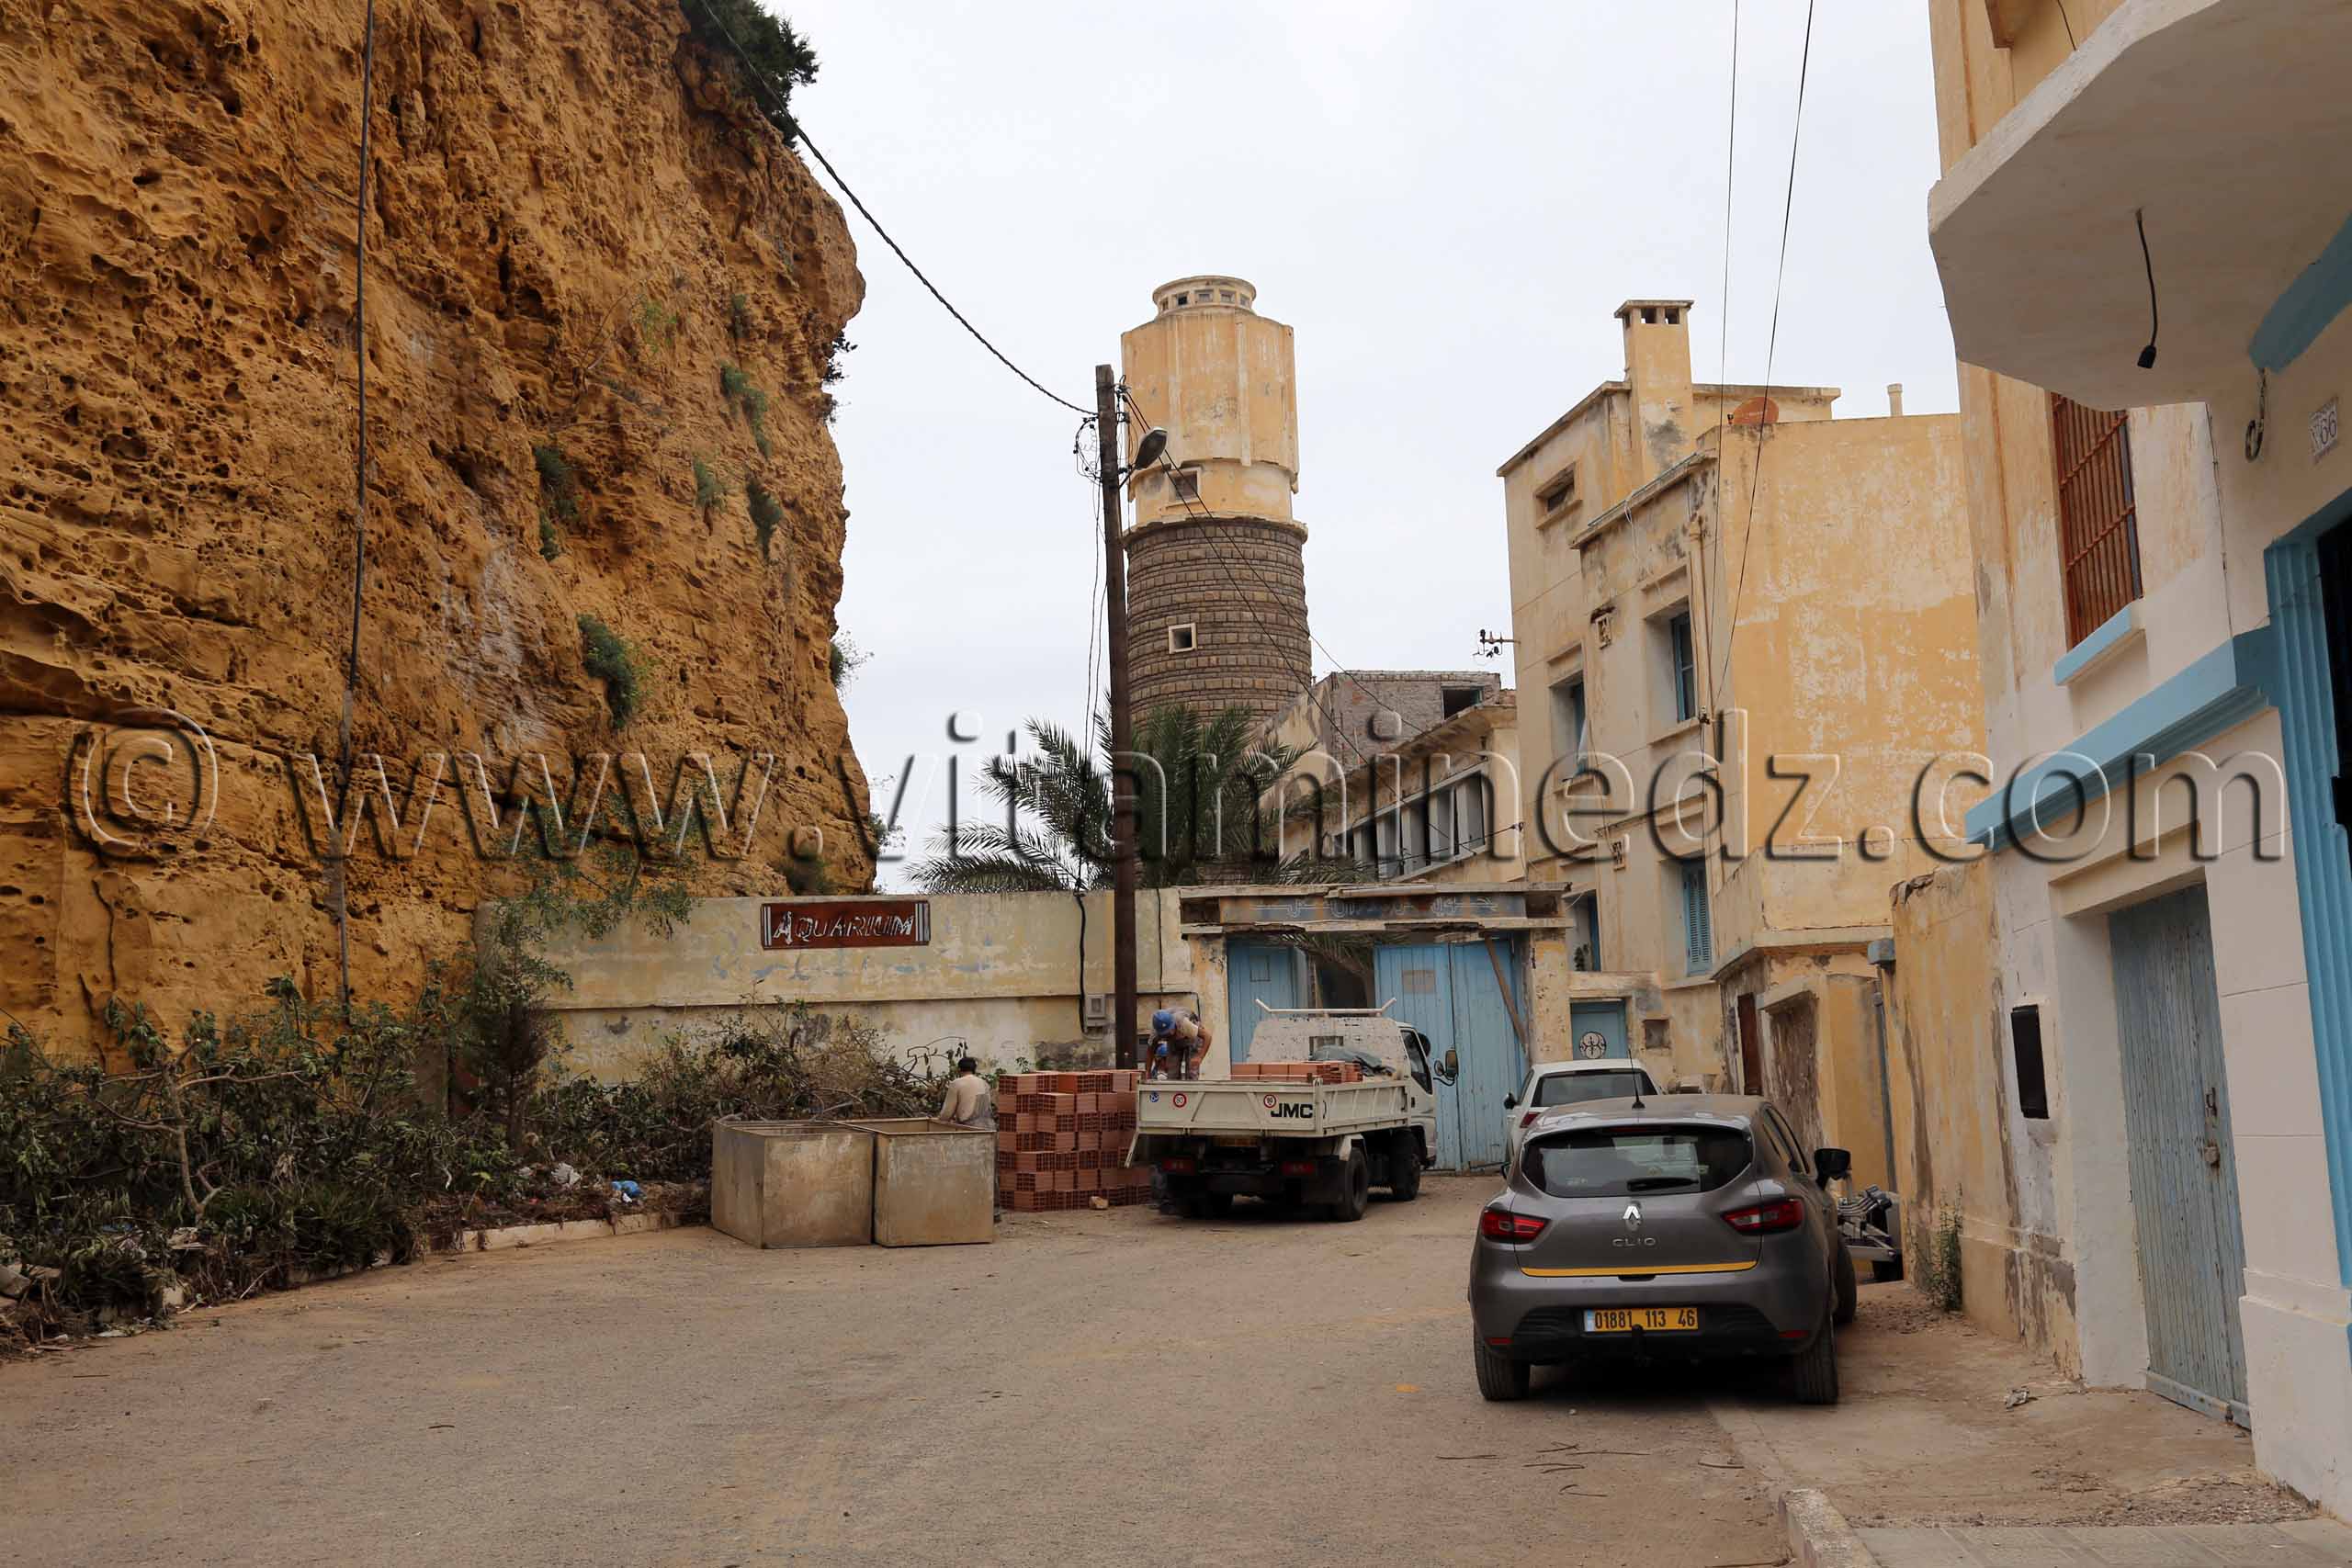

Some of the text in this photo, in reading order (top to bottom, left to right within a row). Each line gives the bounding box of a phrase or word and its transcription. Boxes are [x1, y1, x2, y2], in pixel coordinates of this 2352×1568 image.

[773, 911, 914, 944] AQUARIUM
[1271, 1103, 1313, 1119] JMC
[1612, 1237, 1656, 1247] CLIO
[1594, 1309, 1695, 1329] 01881 113 46
